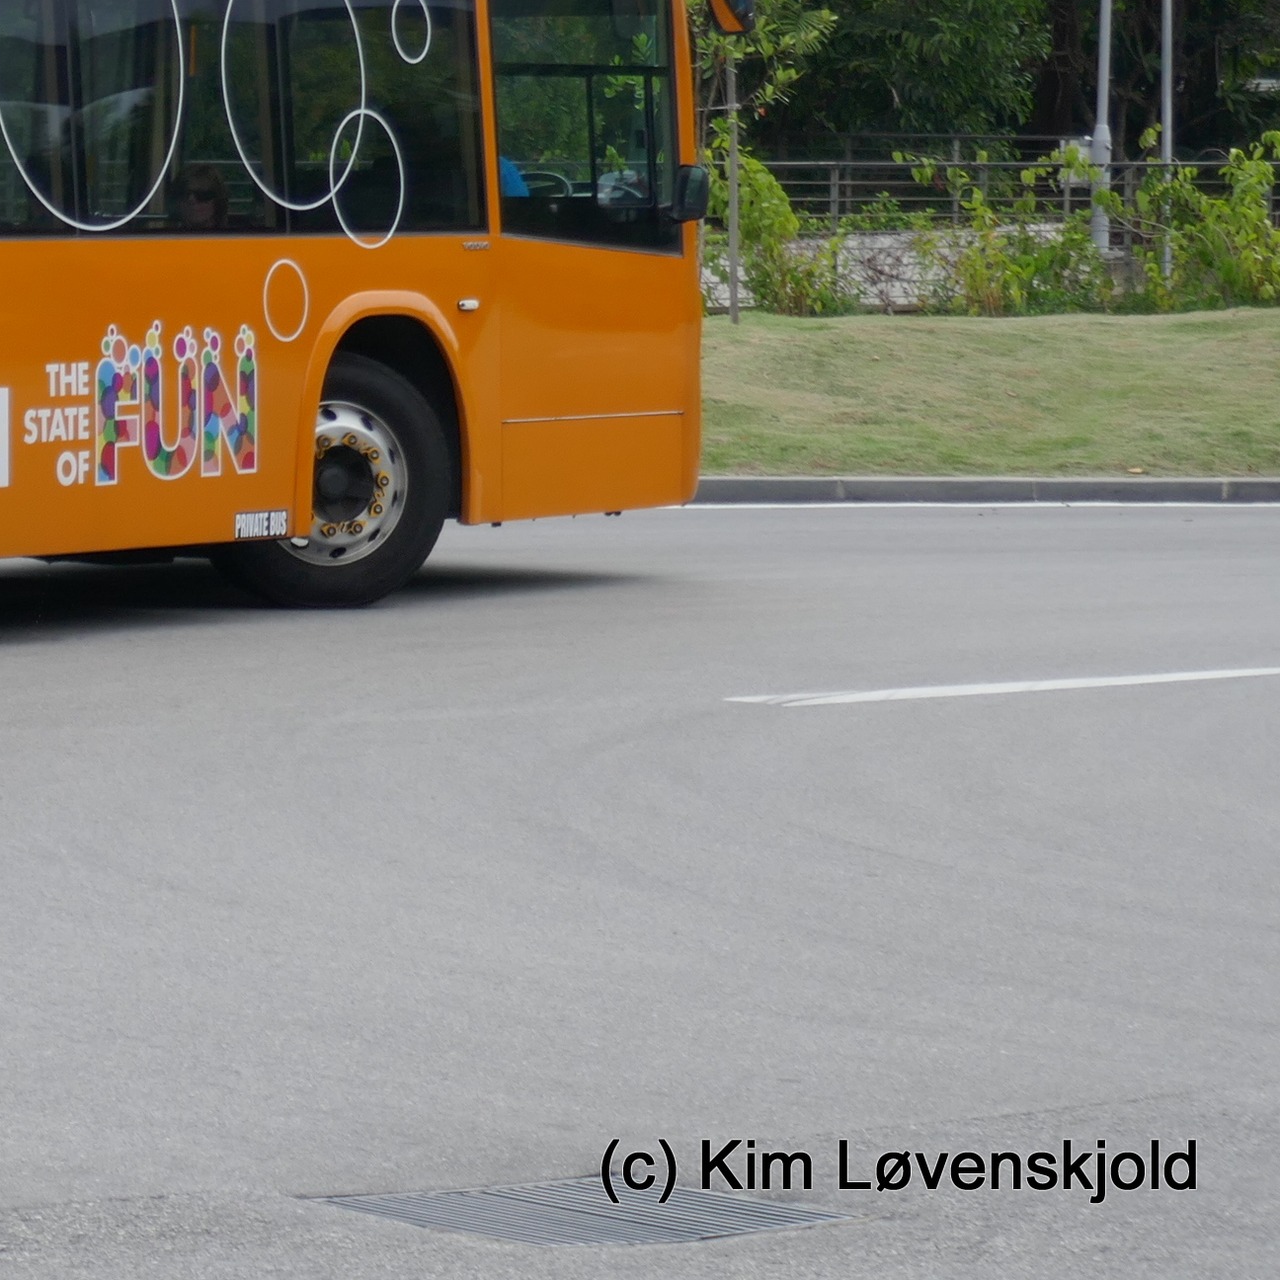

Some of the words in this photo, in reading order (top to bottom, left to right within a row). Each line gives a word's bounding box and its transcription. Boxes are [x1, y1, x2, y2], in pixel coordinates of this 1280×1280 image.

[45, 361, 90, 398] THE
[94, 320, 258, 487] FUN
[23, 406, 90, 445] STATE
[56, 450, 90, 487] OF
[235, 512, 269, 539] PRIVATE
[269, 510, 287, 536] BUS
